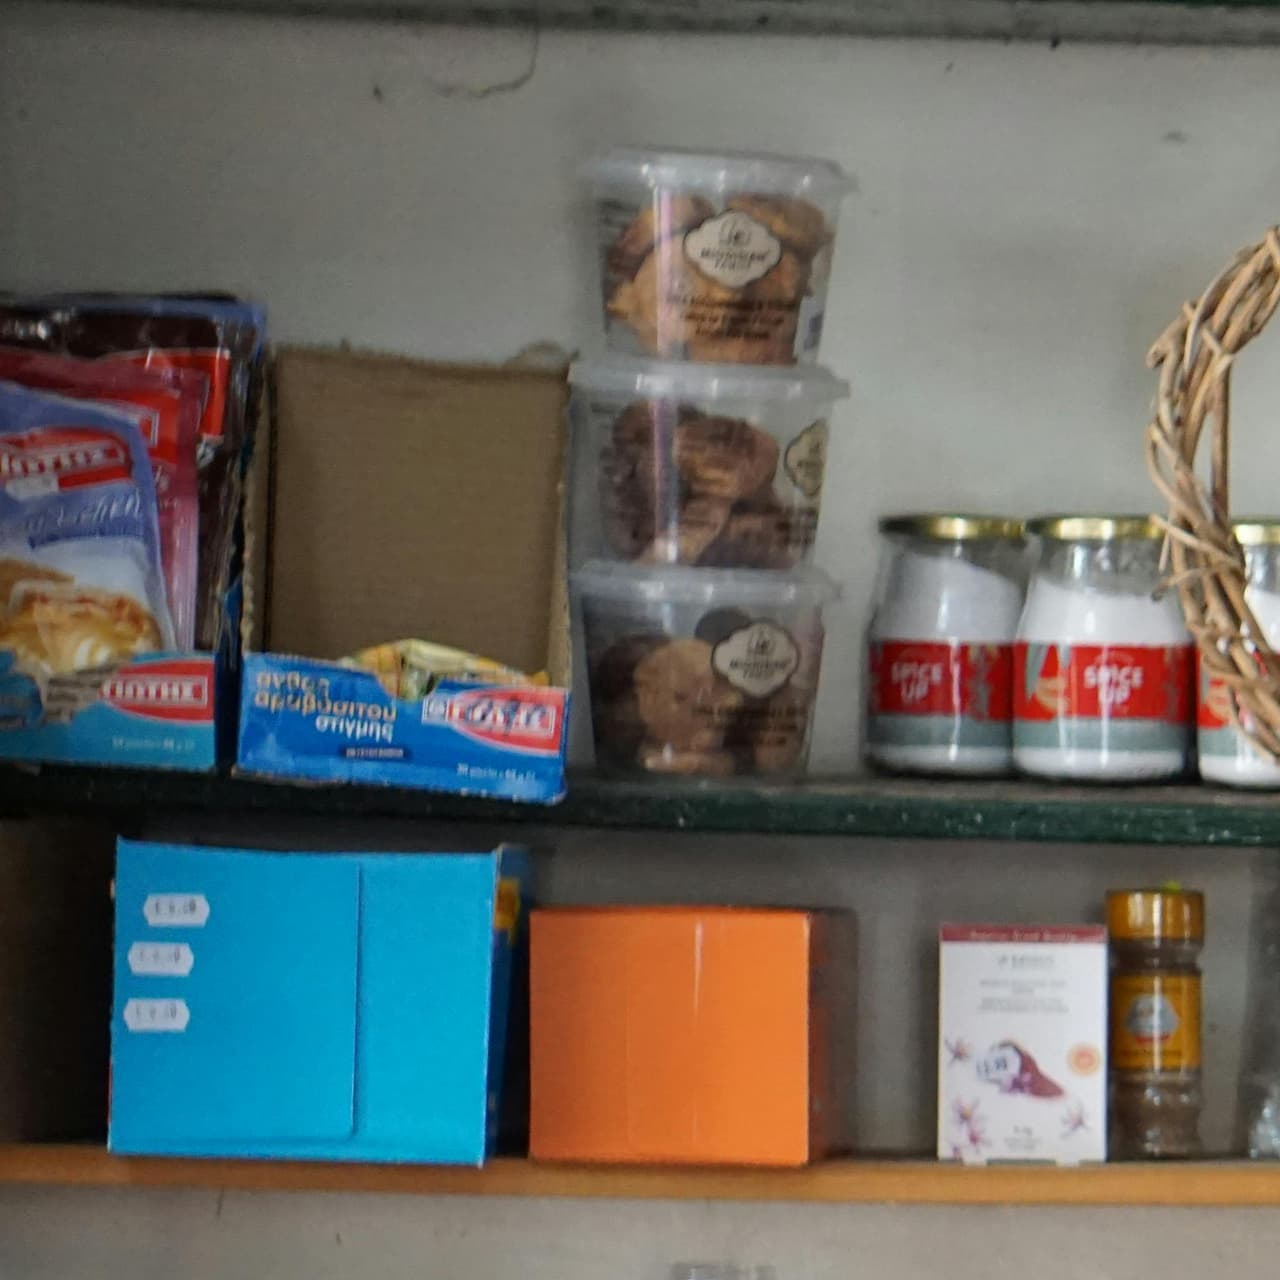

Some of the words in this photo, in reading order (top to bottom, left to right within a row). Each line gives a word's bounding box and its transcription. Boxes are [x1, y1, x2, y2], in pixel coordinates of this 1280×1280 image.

[890, 662, 943, 686] SPICE
[1083, 664, 1143, 689] SPICE
[901, 682, 929, 705] UP
[1098, 684, 1132, 706] UP
